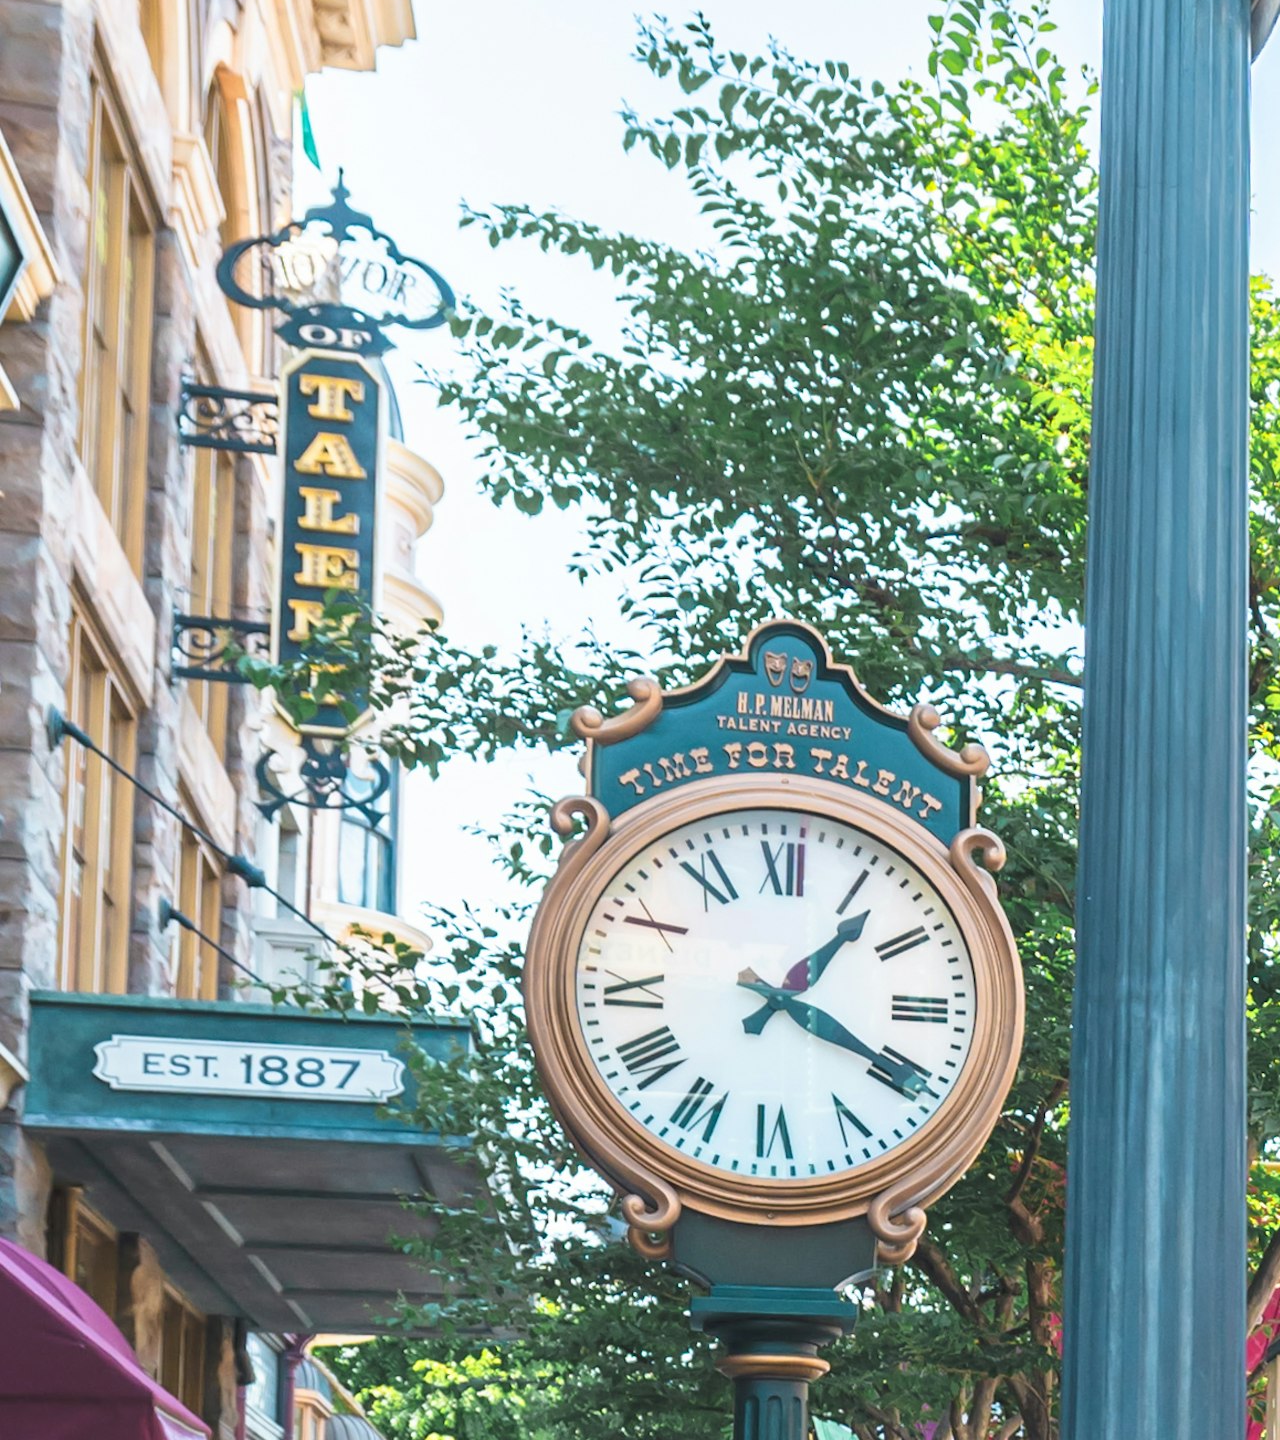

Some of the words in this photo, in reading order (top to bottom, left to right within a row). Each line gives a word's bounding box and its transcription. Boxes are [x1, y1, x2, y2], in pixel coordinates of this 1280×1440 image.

[297, 323, 373, 348] OF
[770, 694, 834, 723] MELMAN
[716, 715, 782, 734] TALENT
[786, 721, 852, 741] AGENCY
[618, 746, 714, 796] TIME
[723, 741, 797, 770] FOR
[810, 747, 944, 820] TALENT
[142, 1052, 220, 1079] EST.
[240, 1053, 362, 1090] 1887
